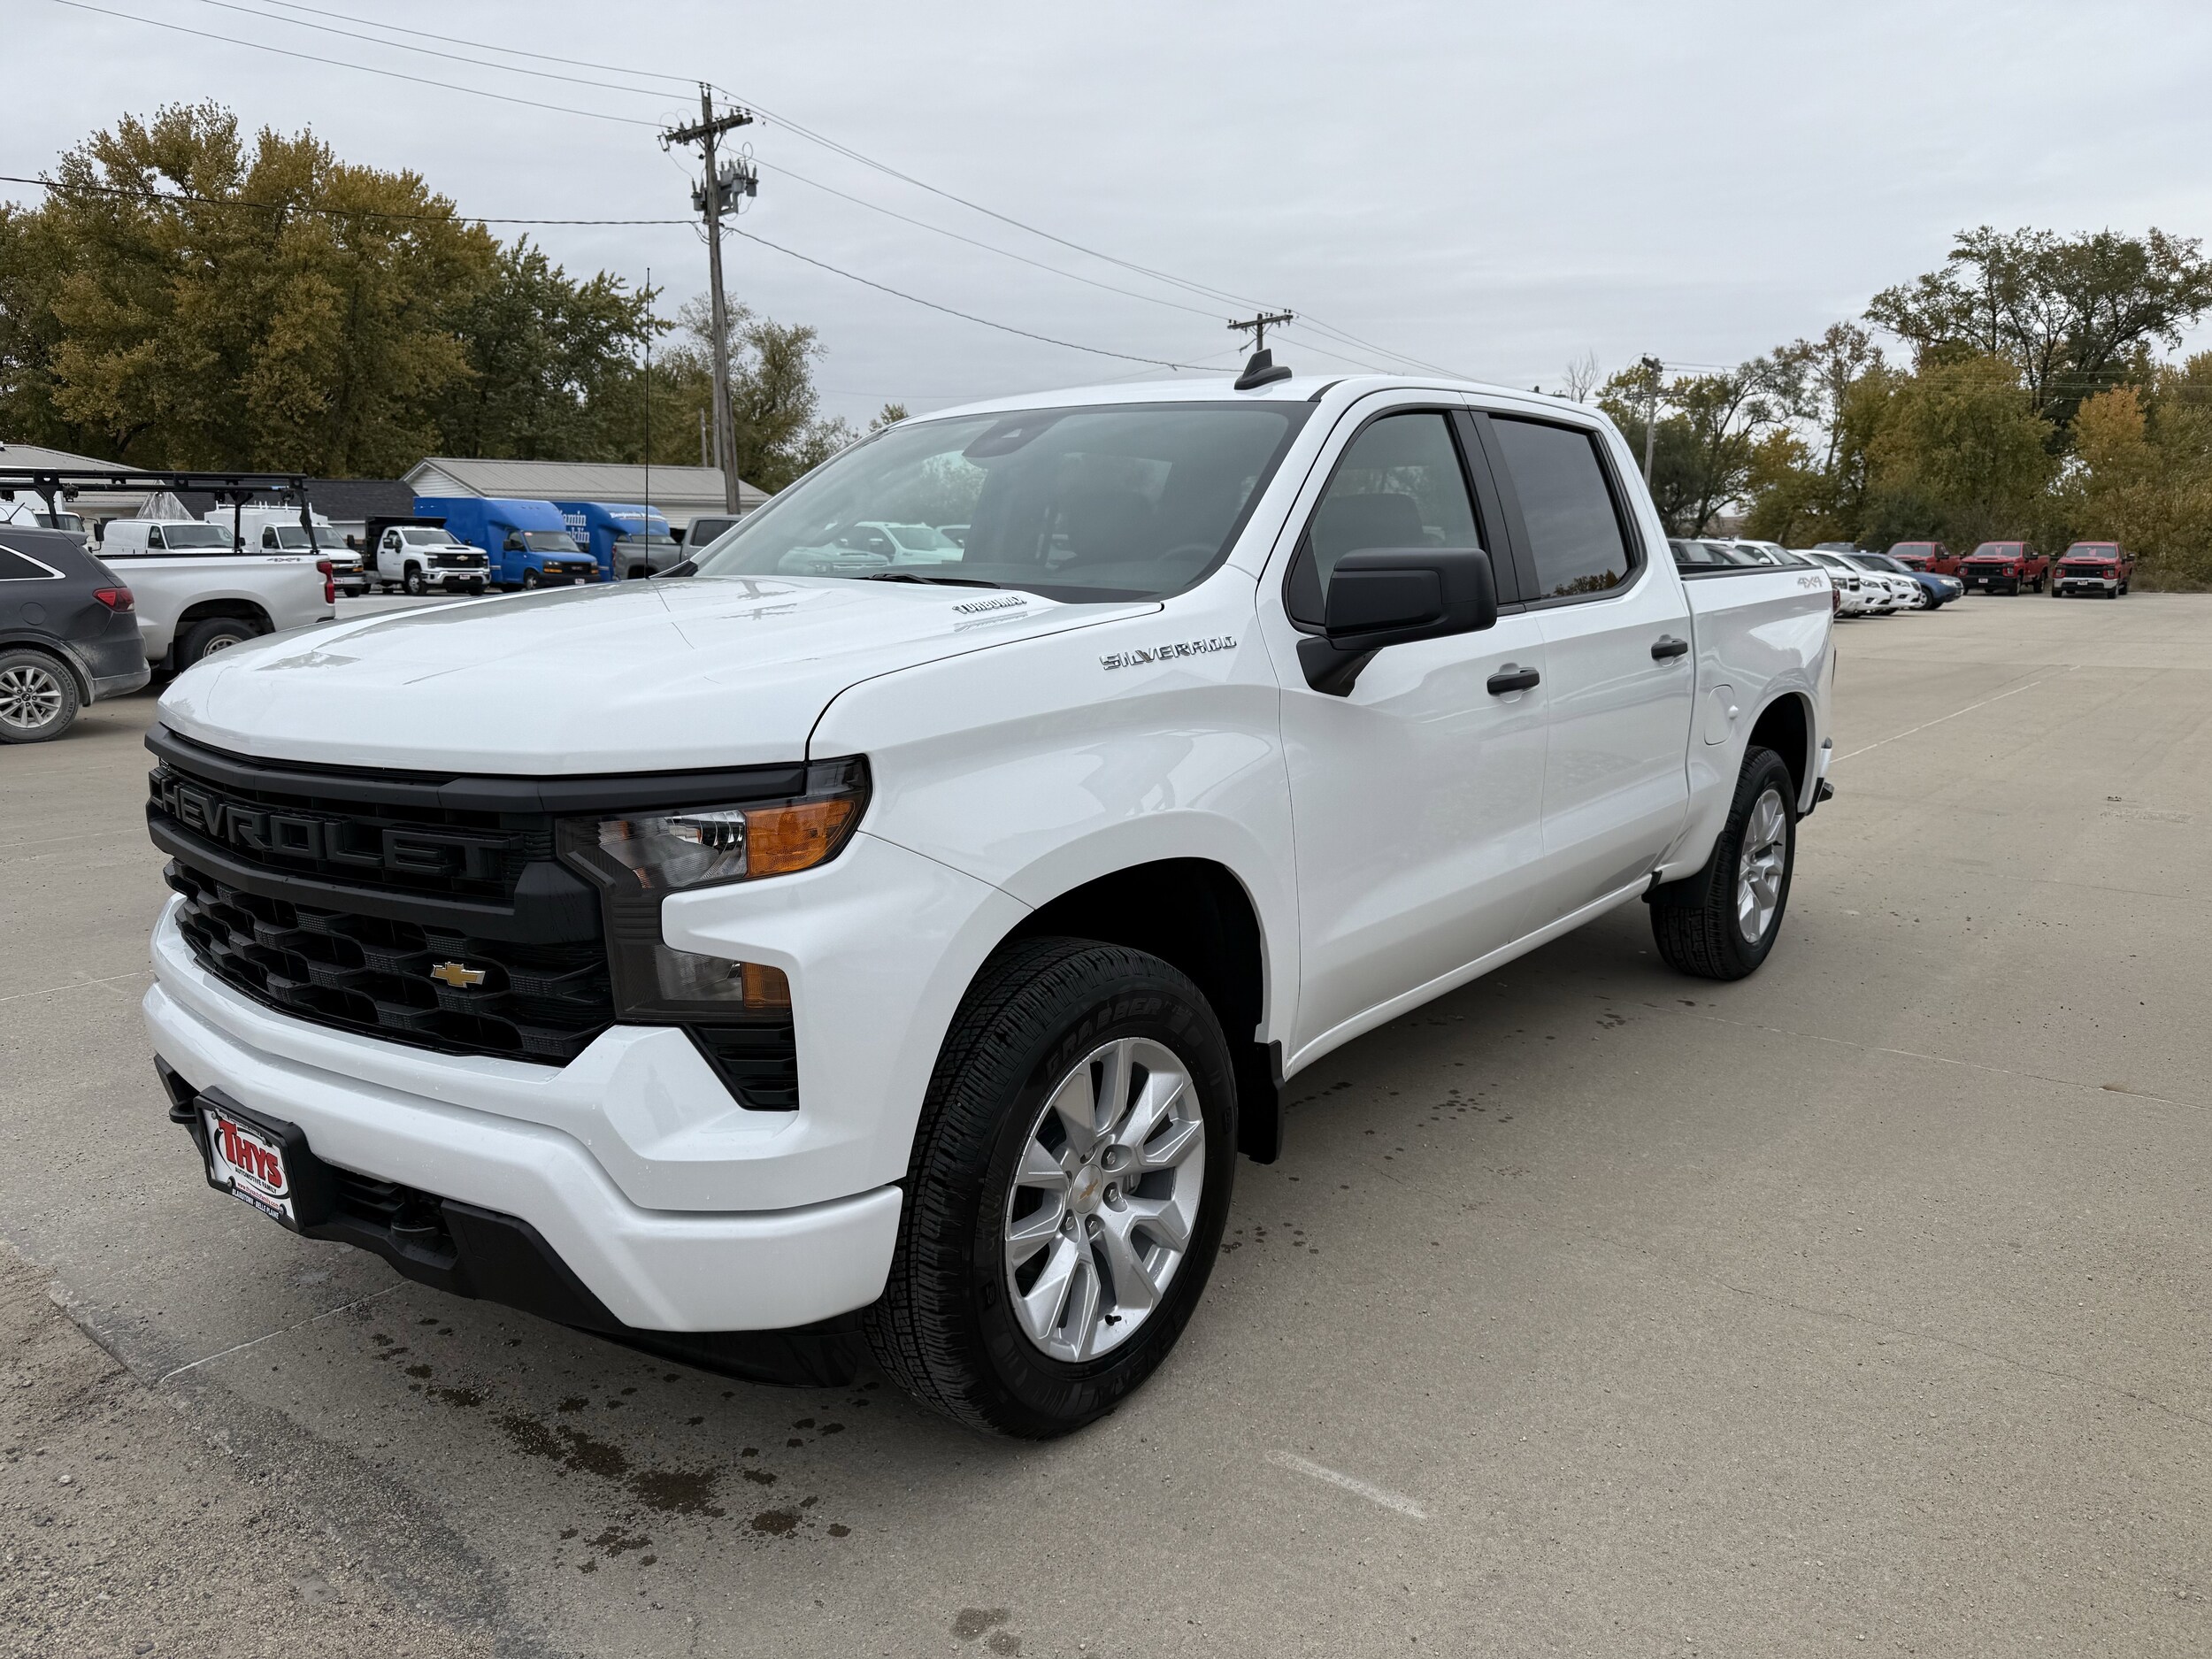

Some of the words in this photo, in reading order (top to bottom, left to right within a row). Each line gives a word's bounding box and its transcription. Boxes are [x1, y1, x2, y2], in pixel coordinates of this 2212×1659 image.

[560, 510, 587, 526] amin
[1099, 635, 1237, 670] SILVERADO
[149, 769, 522, 879] CHEVROLET
[1046, 998, 1163, 1080] GRABBER
[262, 1182, 277, 1194] FAMILY
